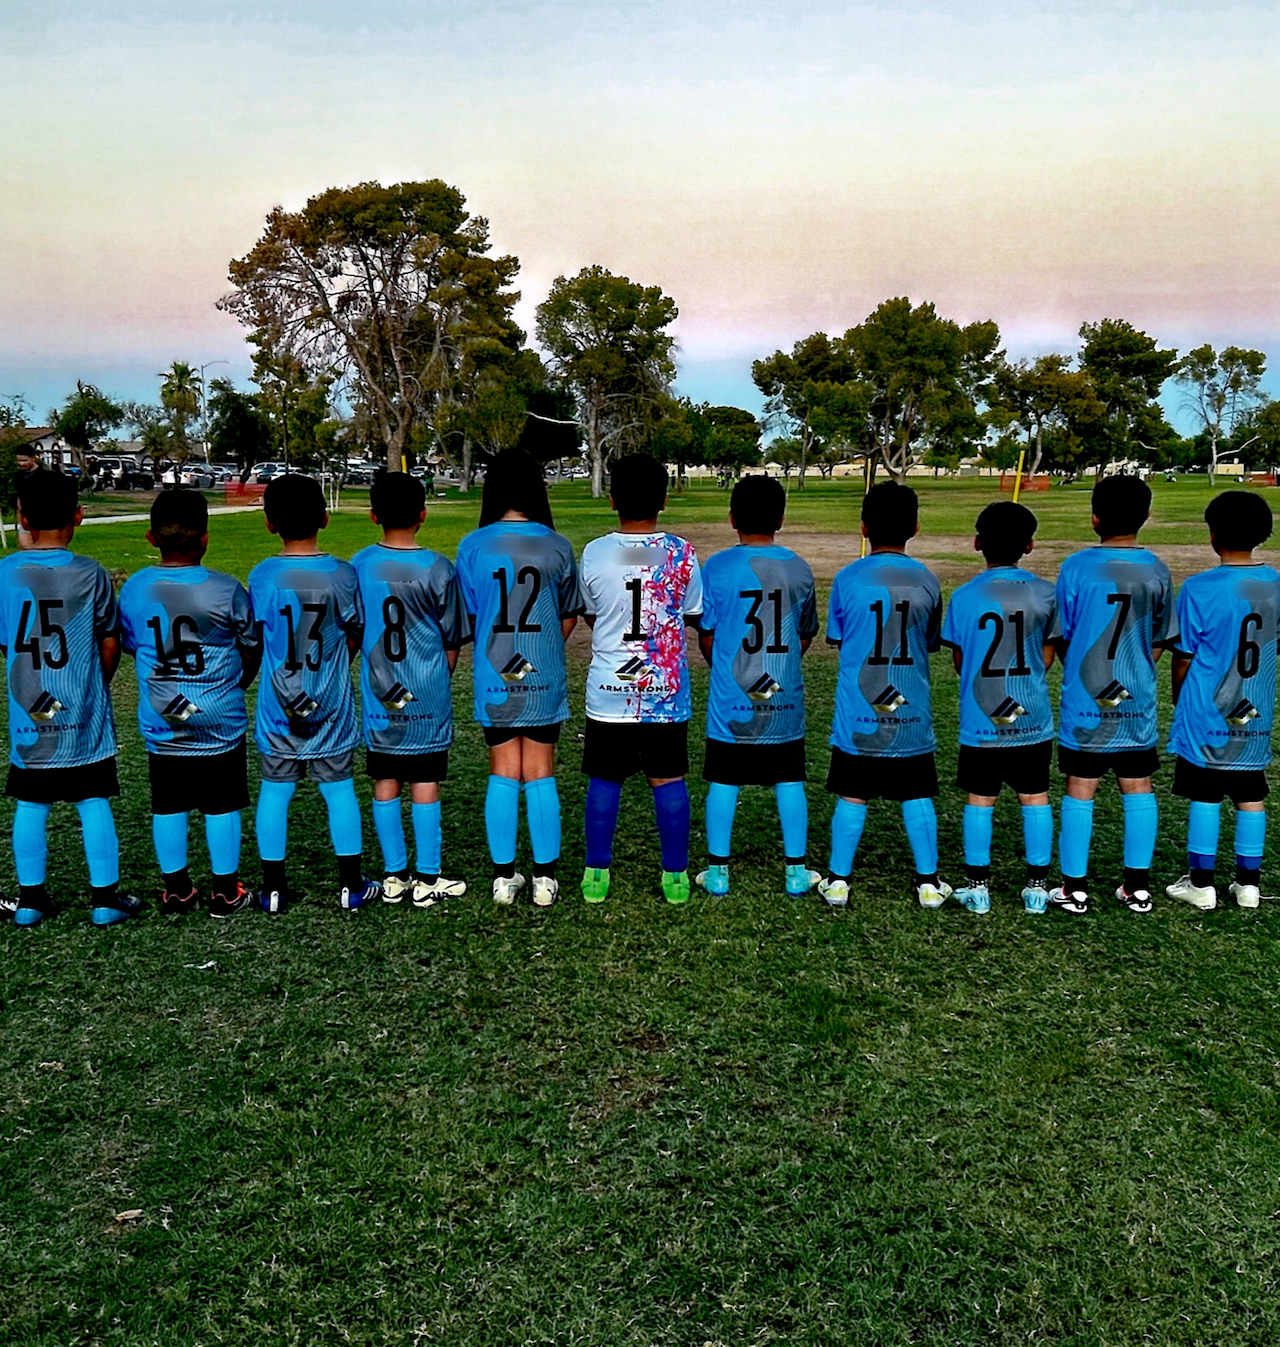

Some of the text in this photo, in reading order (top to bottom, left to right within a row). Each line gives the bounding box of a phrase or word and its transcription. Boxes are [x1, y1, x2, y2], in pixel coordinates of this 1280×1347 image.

[382, 596, 407, 663] 8
[493, 566, 541, 633] 12
[623, 578, 647, 642] 1
[740, 589, 789, 654] 31
[1107, 593, 1131, 660] 7
[14, 599, 69, 670] 45
[147, 615, 205, 676] 16
[280, 604, 328, 671] 13
[868, 600, 914, 666] 11
[979, 611, 1031, 678] 21
[1237, 612, 1263, 678] 6
[369, 712, 434, 721] ARMSTRONG
[486, 684, 550, 693] ARMSTRONG
[732, 704, 795, 713] ARMSTRONG
[856, 715, 921, 724] ARMSTRONG
[1079, 711, 1145, 719] ARMSTRONG
[16, 722, 85, 734] ARMSTRONG
[976, 725, 1042, 736] ARMSTRONG
[1207, 730, 1270, 738] ARMSTRONG
